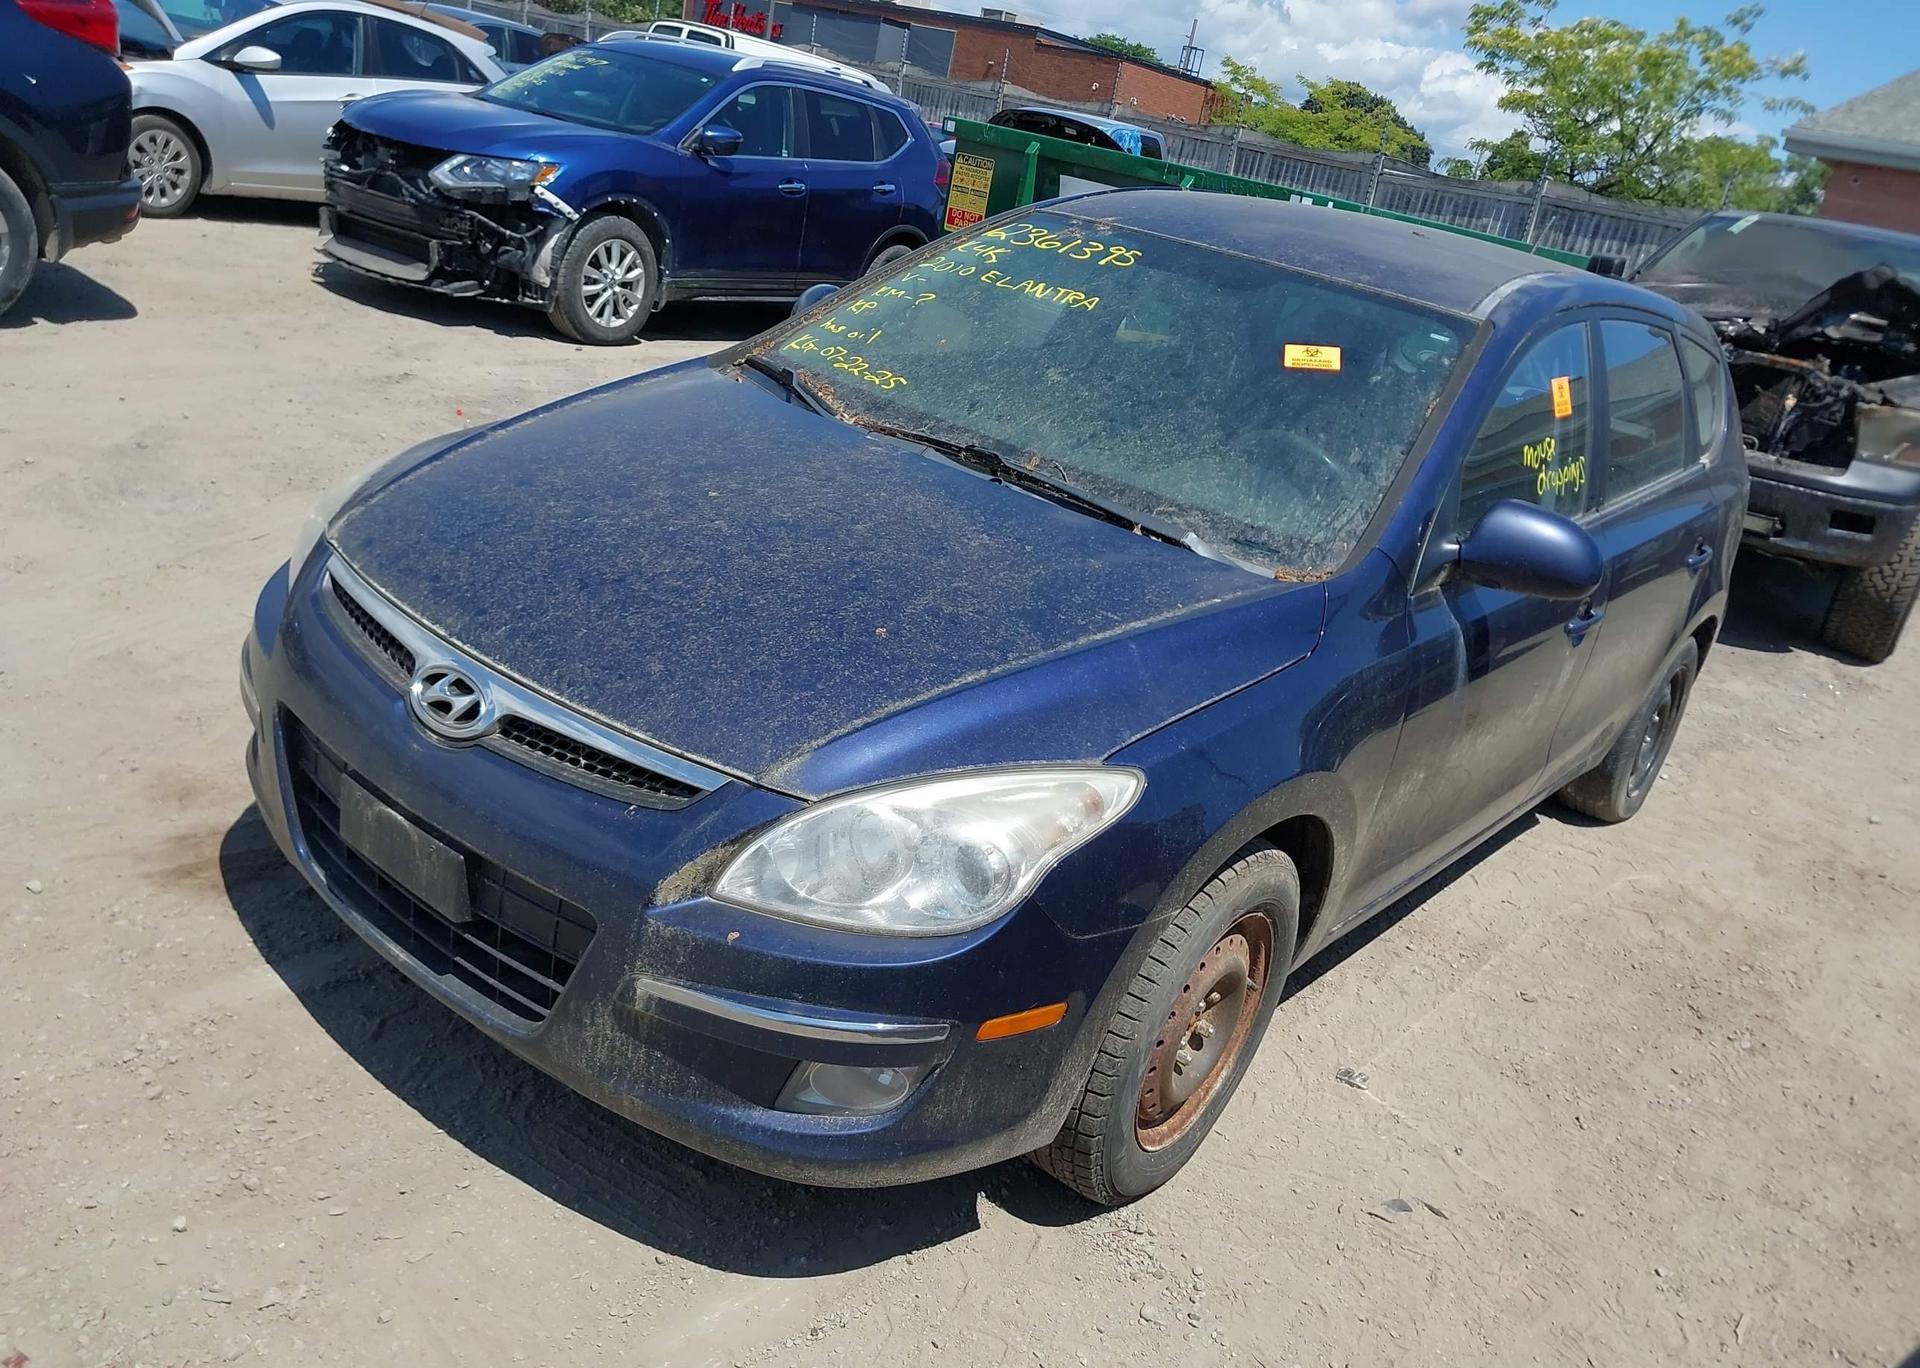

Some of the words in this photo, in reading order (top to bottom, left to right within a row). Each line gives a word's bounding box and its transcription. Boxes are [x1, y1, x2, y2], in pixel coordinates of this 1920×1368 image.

[732, 2, 782, 38] Hortos
[963, 156, 993, 170] CAUTION
[952, 209, 963, 219] DO
[964, 211, 980, 222] NOT
[918, 256, 976, 276] 2010
[980, 270, 1100, 312] ELANTRA
[1523, 437, 1556, 469] mouse
[1537, 455, 1586, 497] droppings
